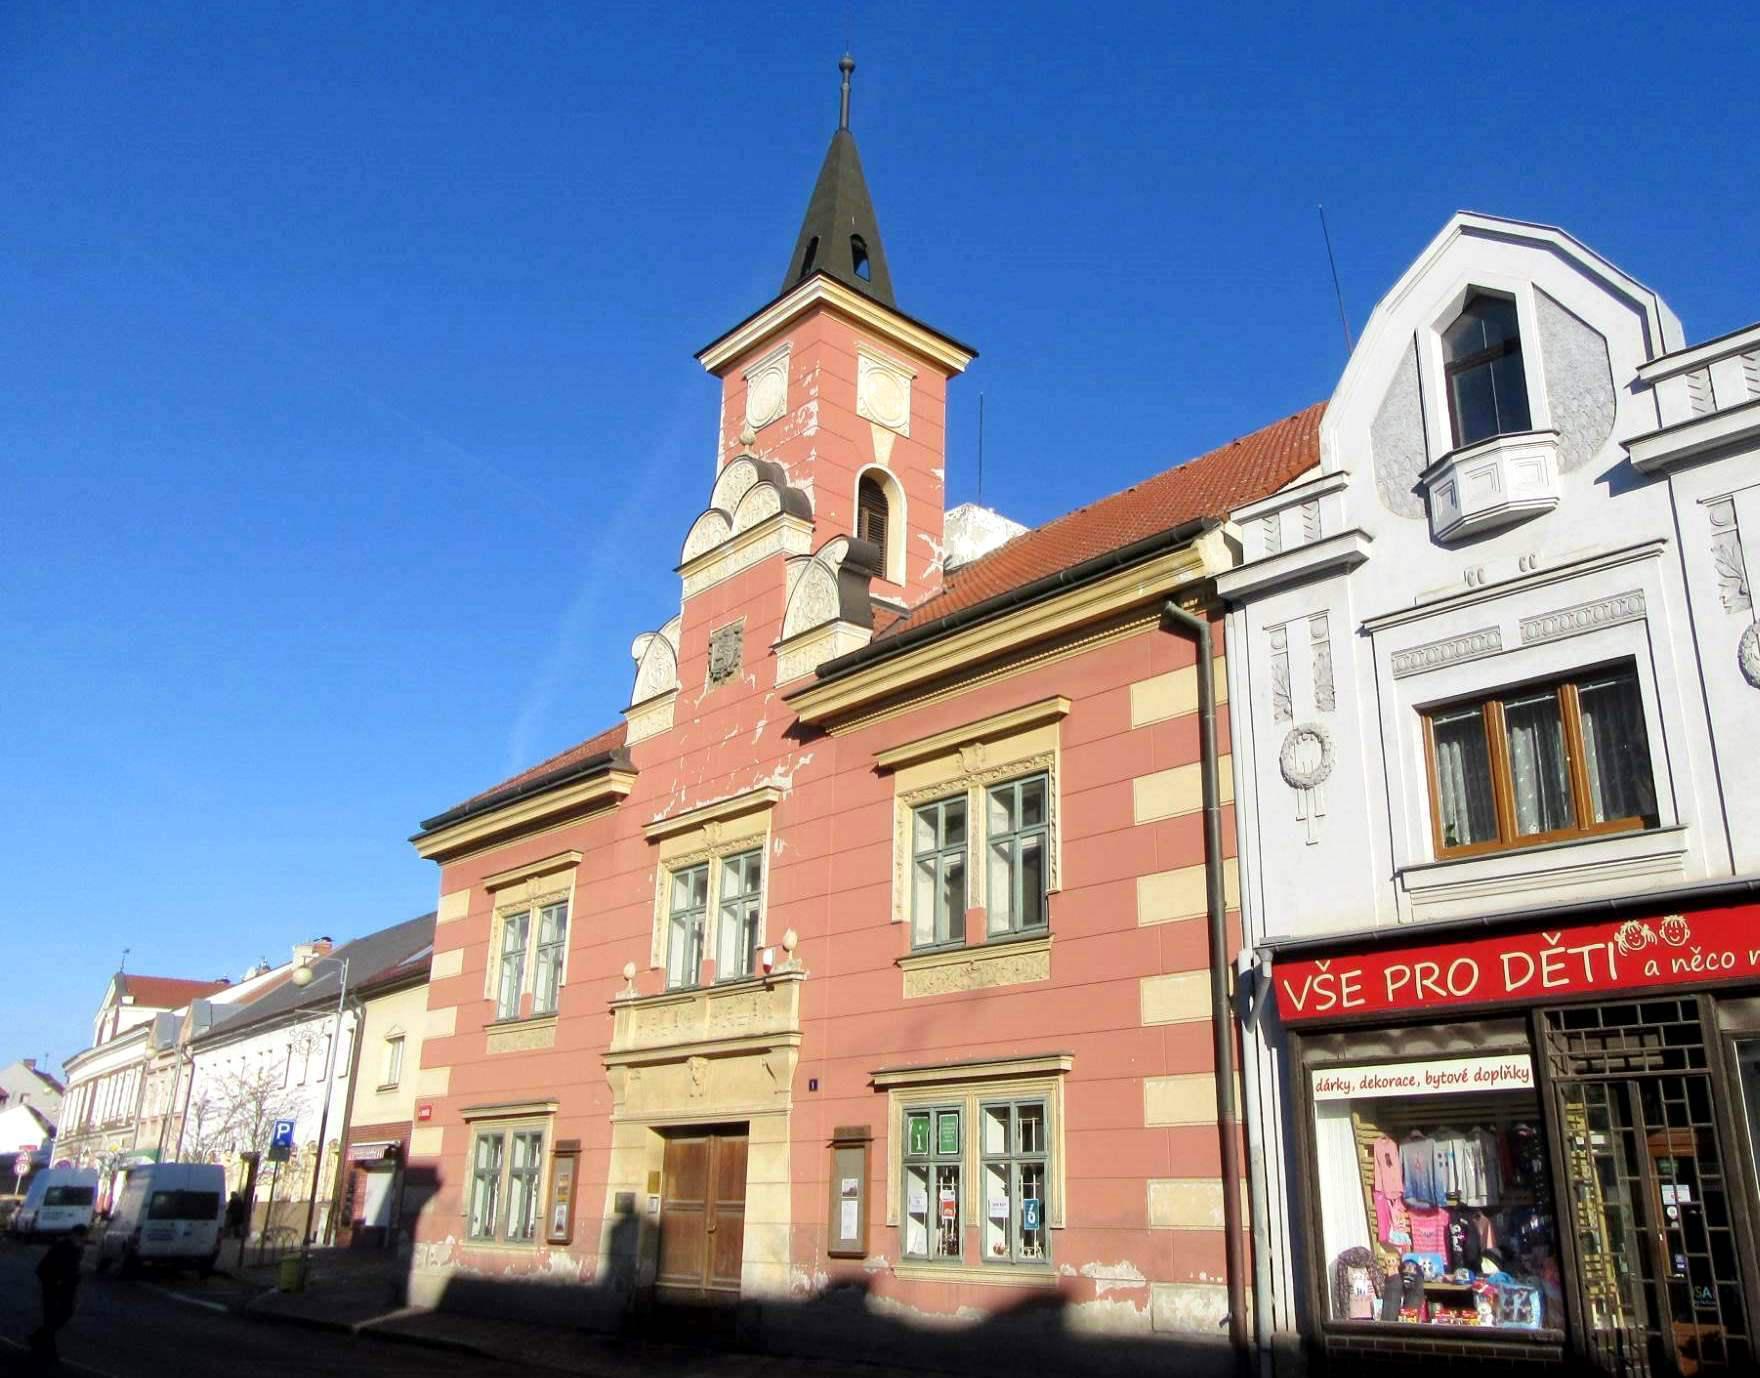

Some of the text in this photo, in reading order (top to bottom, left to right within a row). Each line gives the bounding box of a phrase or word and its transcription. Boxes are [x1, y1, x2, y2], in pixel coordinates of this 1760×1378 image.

[1283, 932, 1618, 1011] VŠE PRO DĚTI
[1644, 960, 1660, 976] a
[1671, 946, 1735, 973] něco
[1315, 1064, 1530, 1094] dárky, dekorace, bytové doplňky
[276, 1123, 290, 1139] P
[1027, 1203, 1036, 1224] 6
